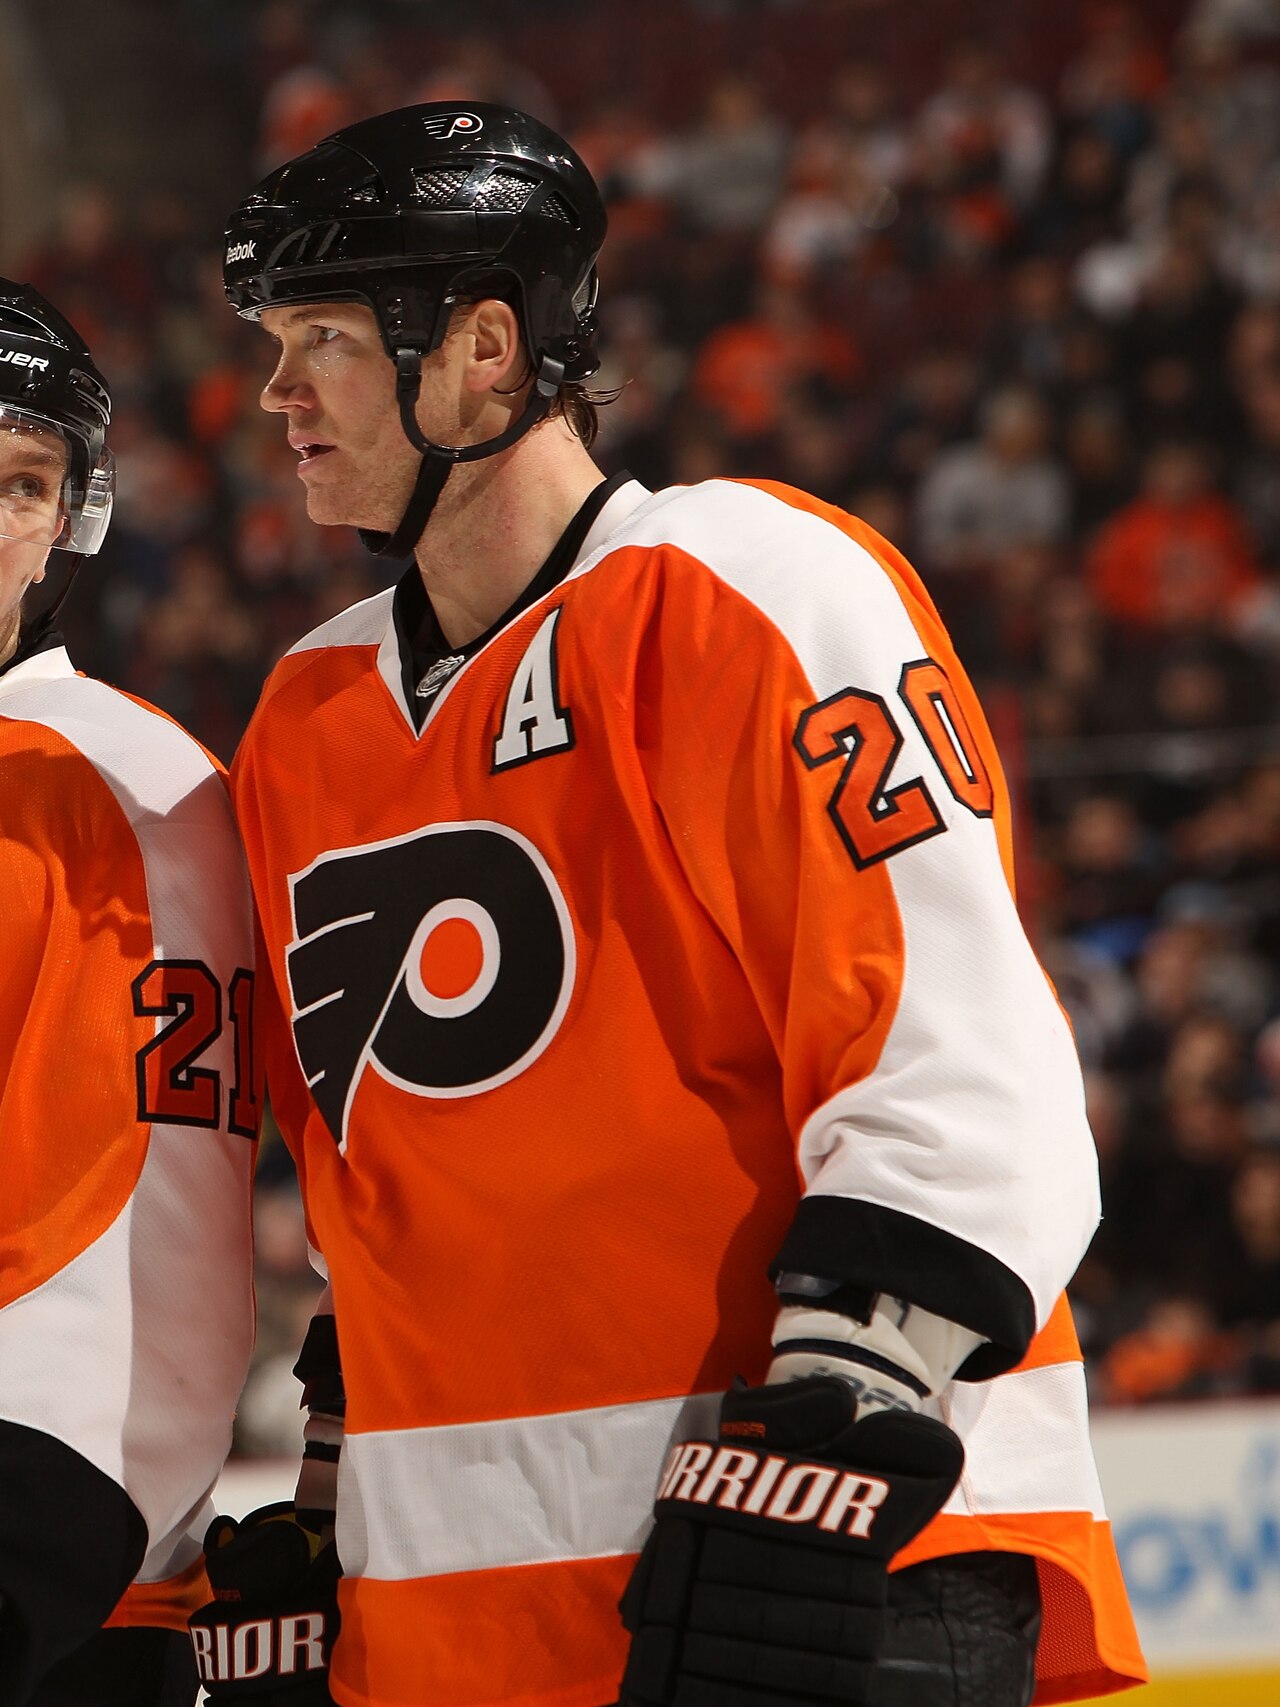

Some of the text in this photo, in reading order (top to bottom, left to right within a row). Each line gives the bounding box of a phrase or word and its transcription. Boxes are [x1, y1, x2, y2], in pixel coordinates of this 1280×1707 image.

[490, 602, 576, 776] A
[792, 657, 994, 872] 20
[131, 959, 257, 1140] 21
